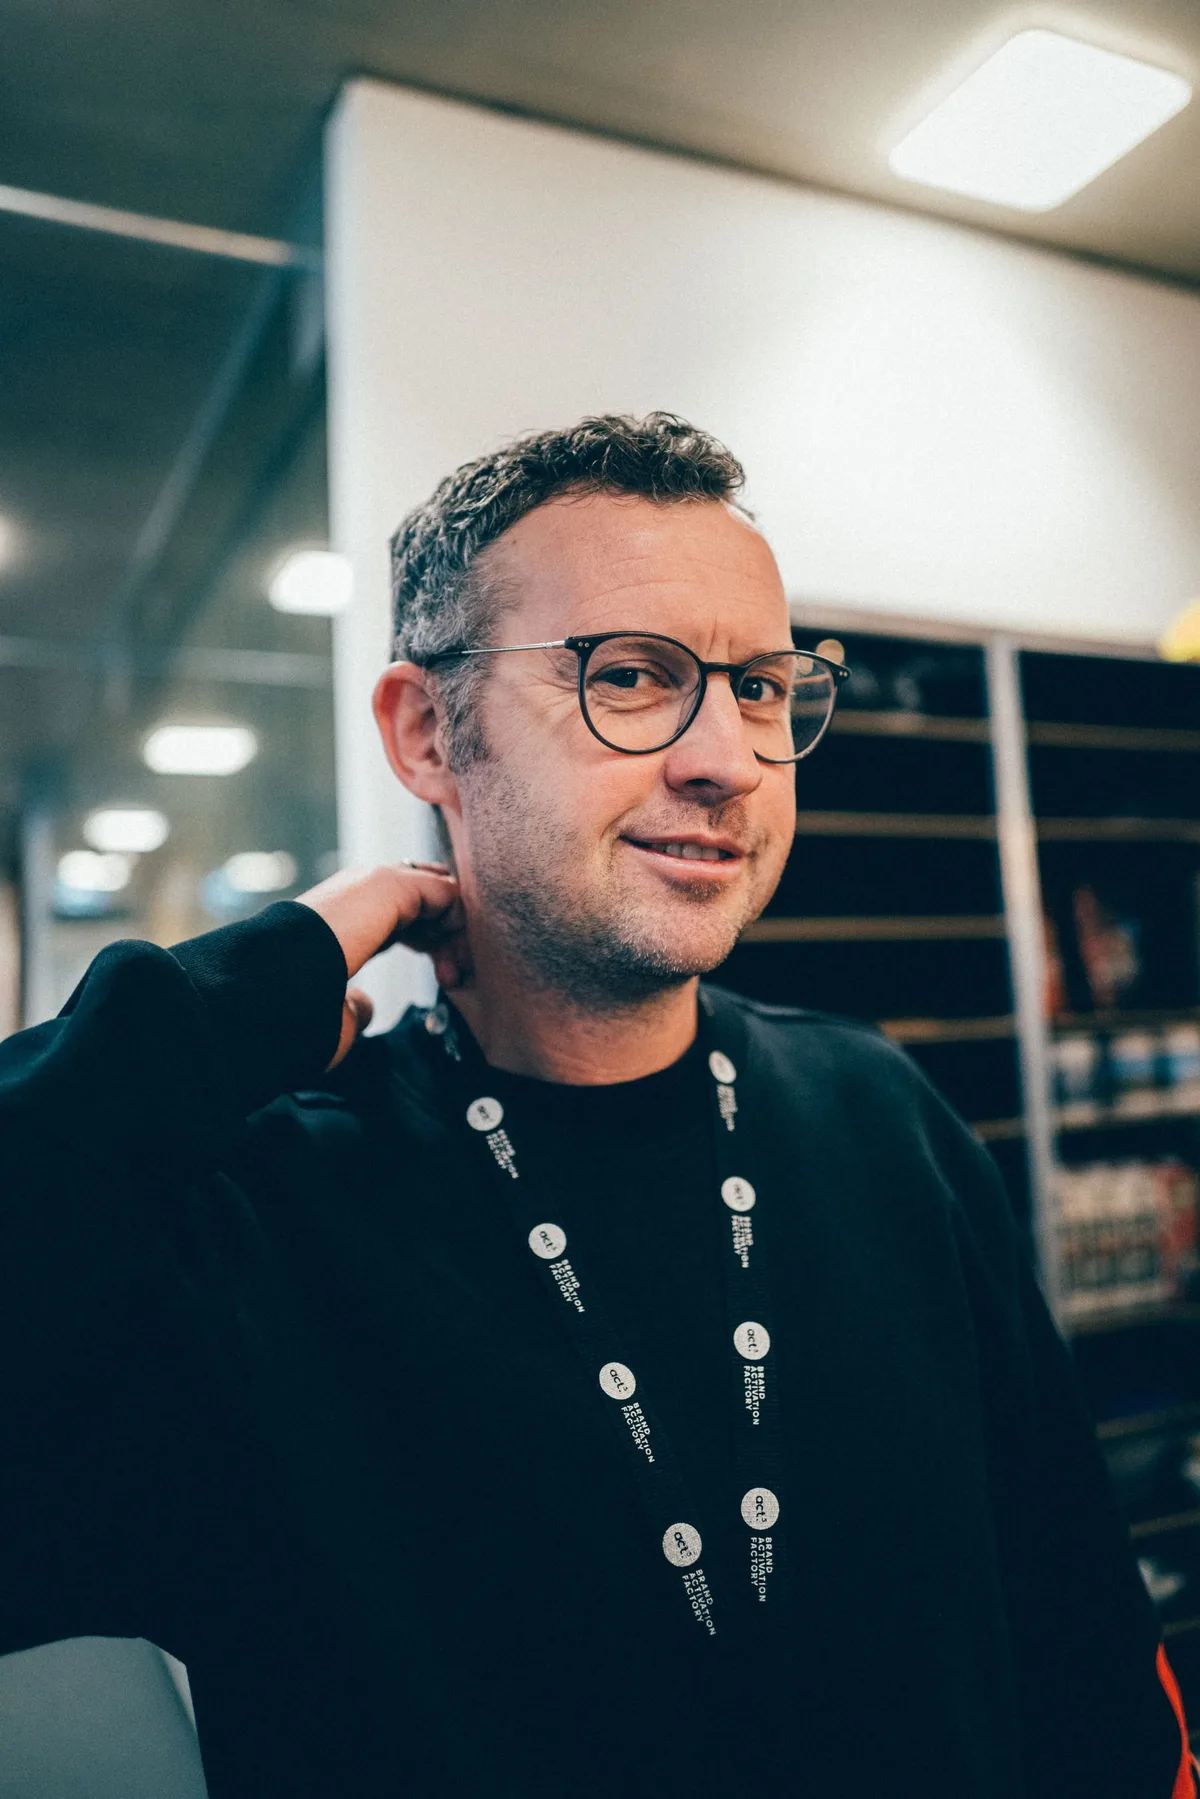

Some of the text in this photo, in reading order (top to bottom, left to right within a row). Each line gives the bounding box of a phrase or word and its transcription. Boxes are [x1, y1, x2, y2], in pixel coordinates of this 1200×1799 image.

[743, 1365, 752, 1411] FACTORY
[750, 1366, 760, 1425] ACTIVATION
[758, 1366, 766, 1400] BRAND
[621, 1406, 644, 1450] FACTORY
[626, 1405, 655, 1463] ACTIVATION
[633, 1402, 651, 1435] BRAND
[750, 1537, 758, 1587] FACTORY
[758, 1537, 766, 1602] ACTIVATION
[765, 1537, 773, 1573] BRAND
[682, 1574, 704, 1622] FACTORY
[689, 1572, 716, 1636] ACTIVATION
[695, 1569, 713, 1605] BRAND
